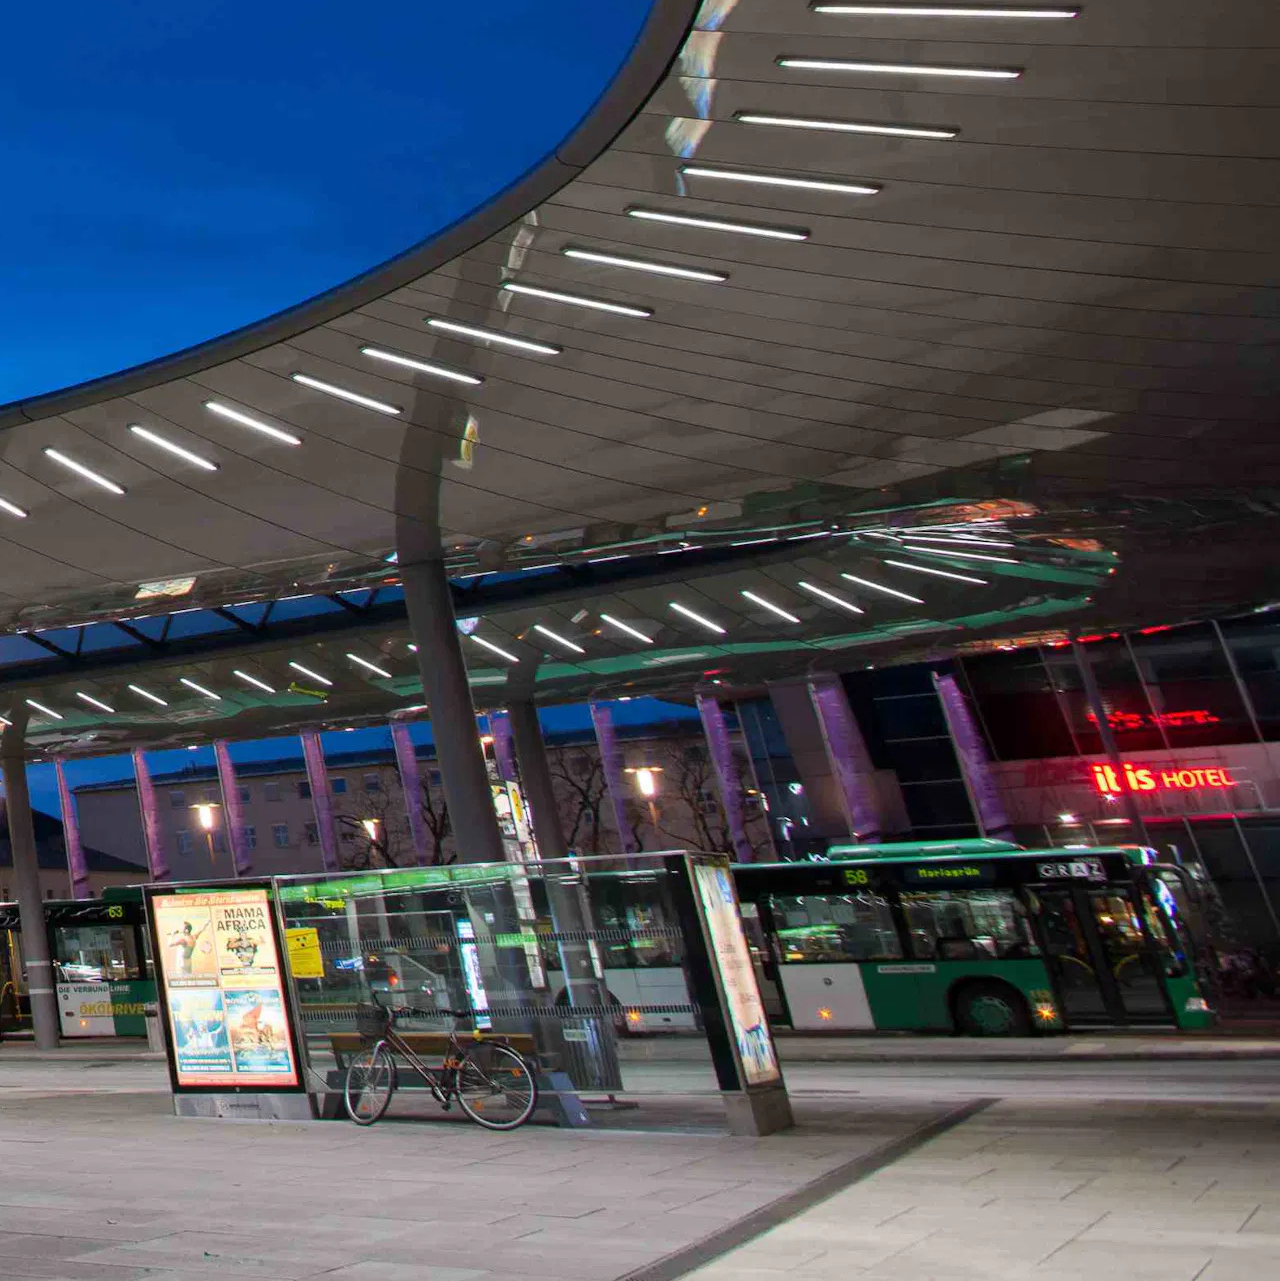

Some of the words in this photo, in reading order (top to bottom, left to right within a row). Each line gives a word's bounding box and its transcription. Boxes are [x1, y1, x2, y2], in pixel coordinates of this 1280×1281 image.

[1161, 769, 1236, 788] HOTEL
[844, 869, 868, 886] 58
[107, 904, 123, 918] 63
[223, 907, 265, 920] MAMA
[58, 985, 71, 994] DIE
